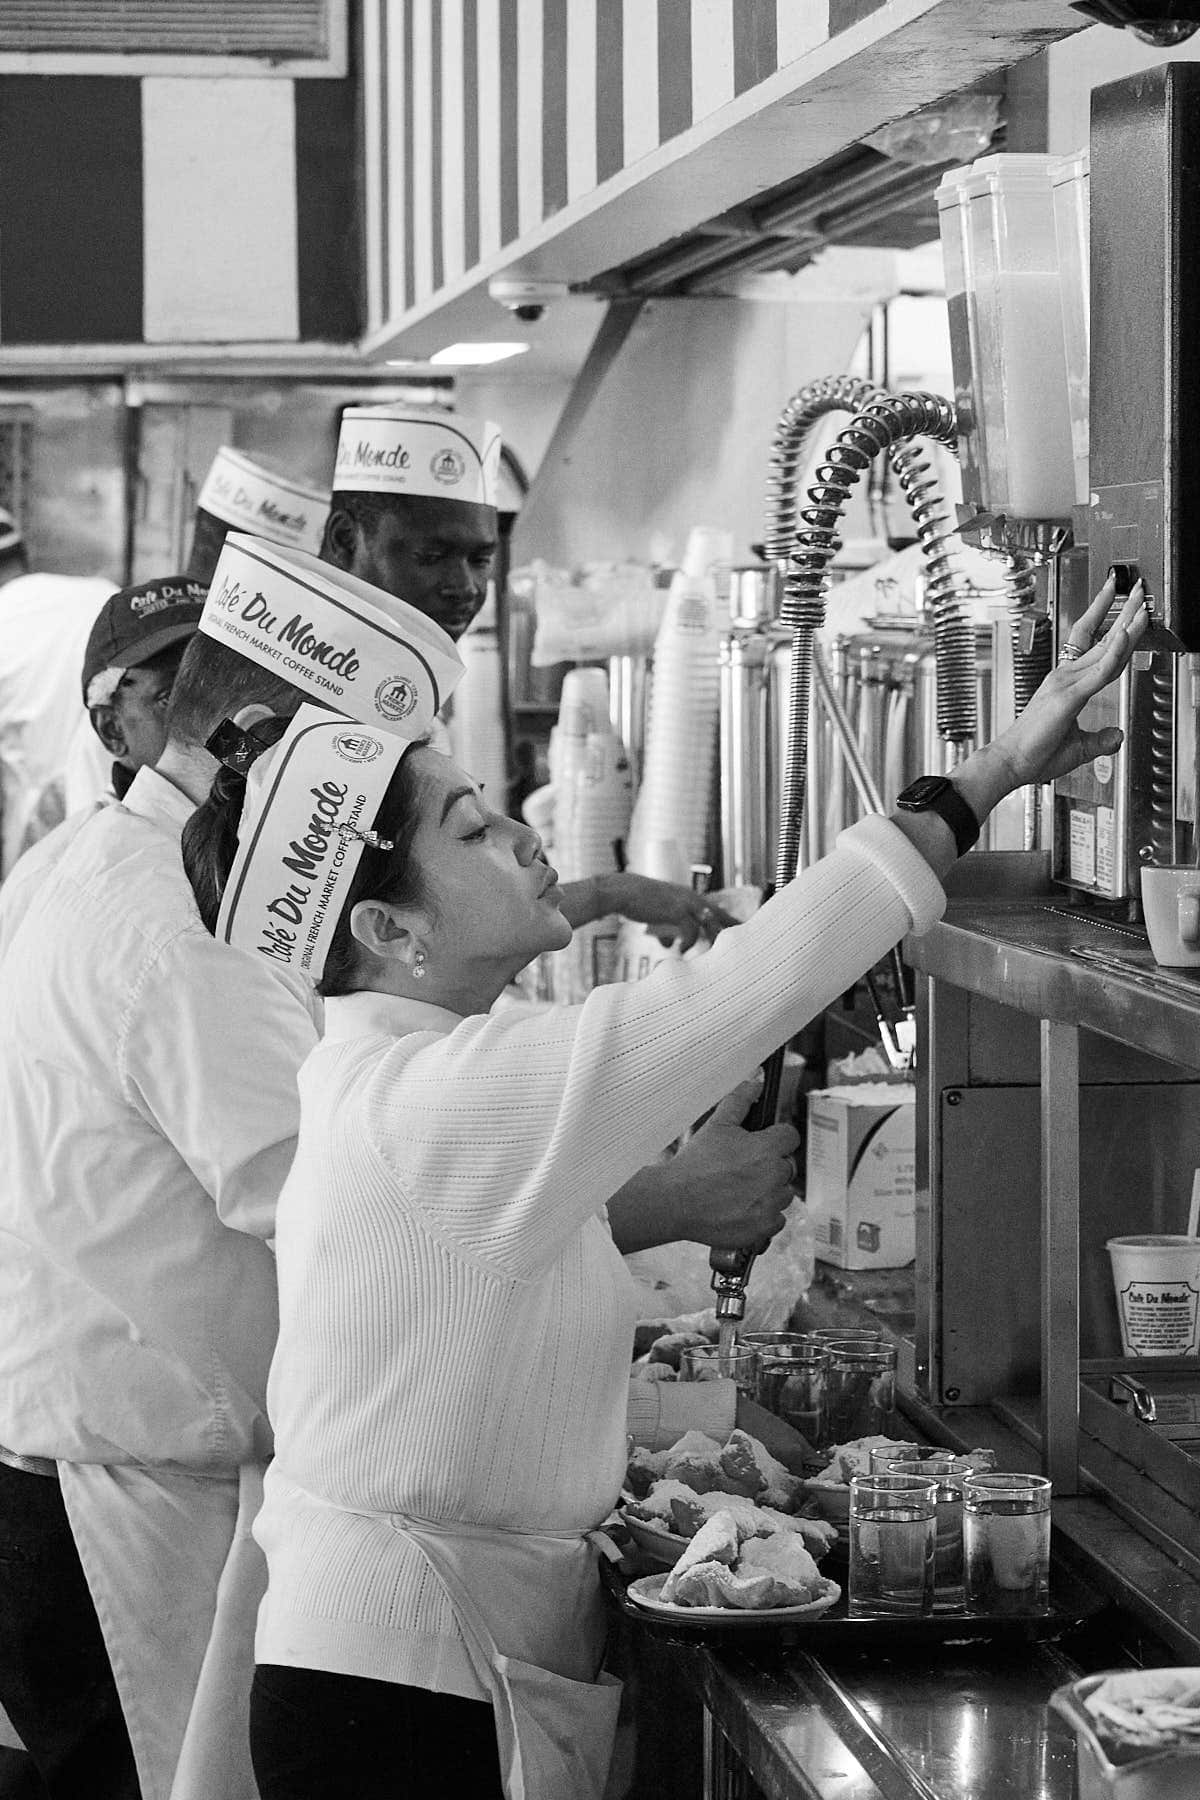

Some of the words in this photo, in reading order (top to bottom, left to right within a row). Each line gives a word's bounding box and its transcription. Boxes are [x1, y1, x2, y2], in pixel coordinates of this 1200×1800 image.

[355, 441, 411, 470] Monde
[223, 621, 250, 642] FRENCH
[250, 637, 283, 661] MARKET
[282, 656, 315, 680] COFFEE
[315, 675, 344, 696] STAND
[241, 592, 278, 634] Du
[277, 614, 360, 682] Monde
[282, 781, 348, 880] Monde
[266, 884, 312, 925] Du
[306, 910, 326, 944] FRENCH
[317, 869, 340, 910] MARKET
[347, 794, 367, 827] STAND
[256, 921, 297, 963] Café
